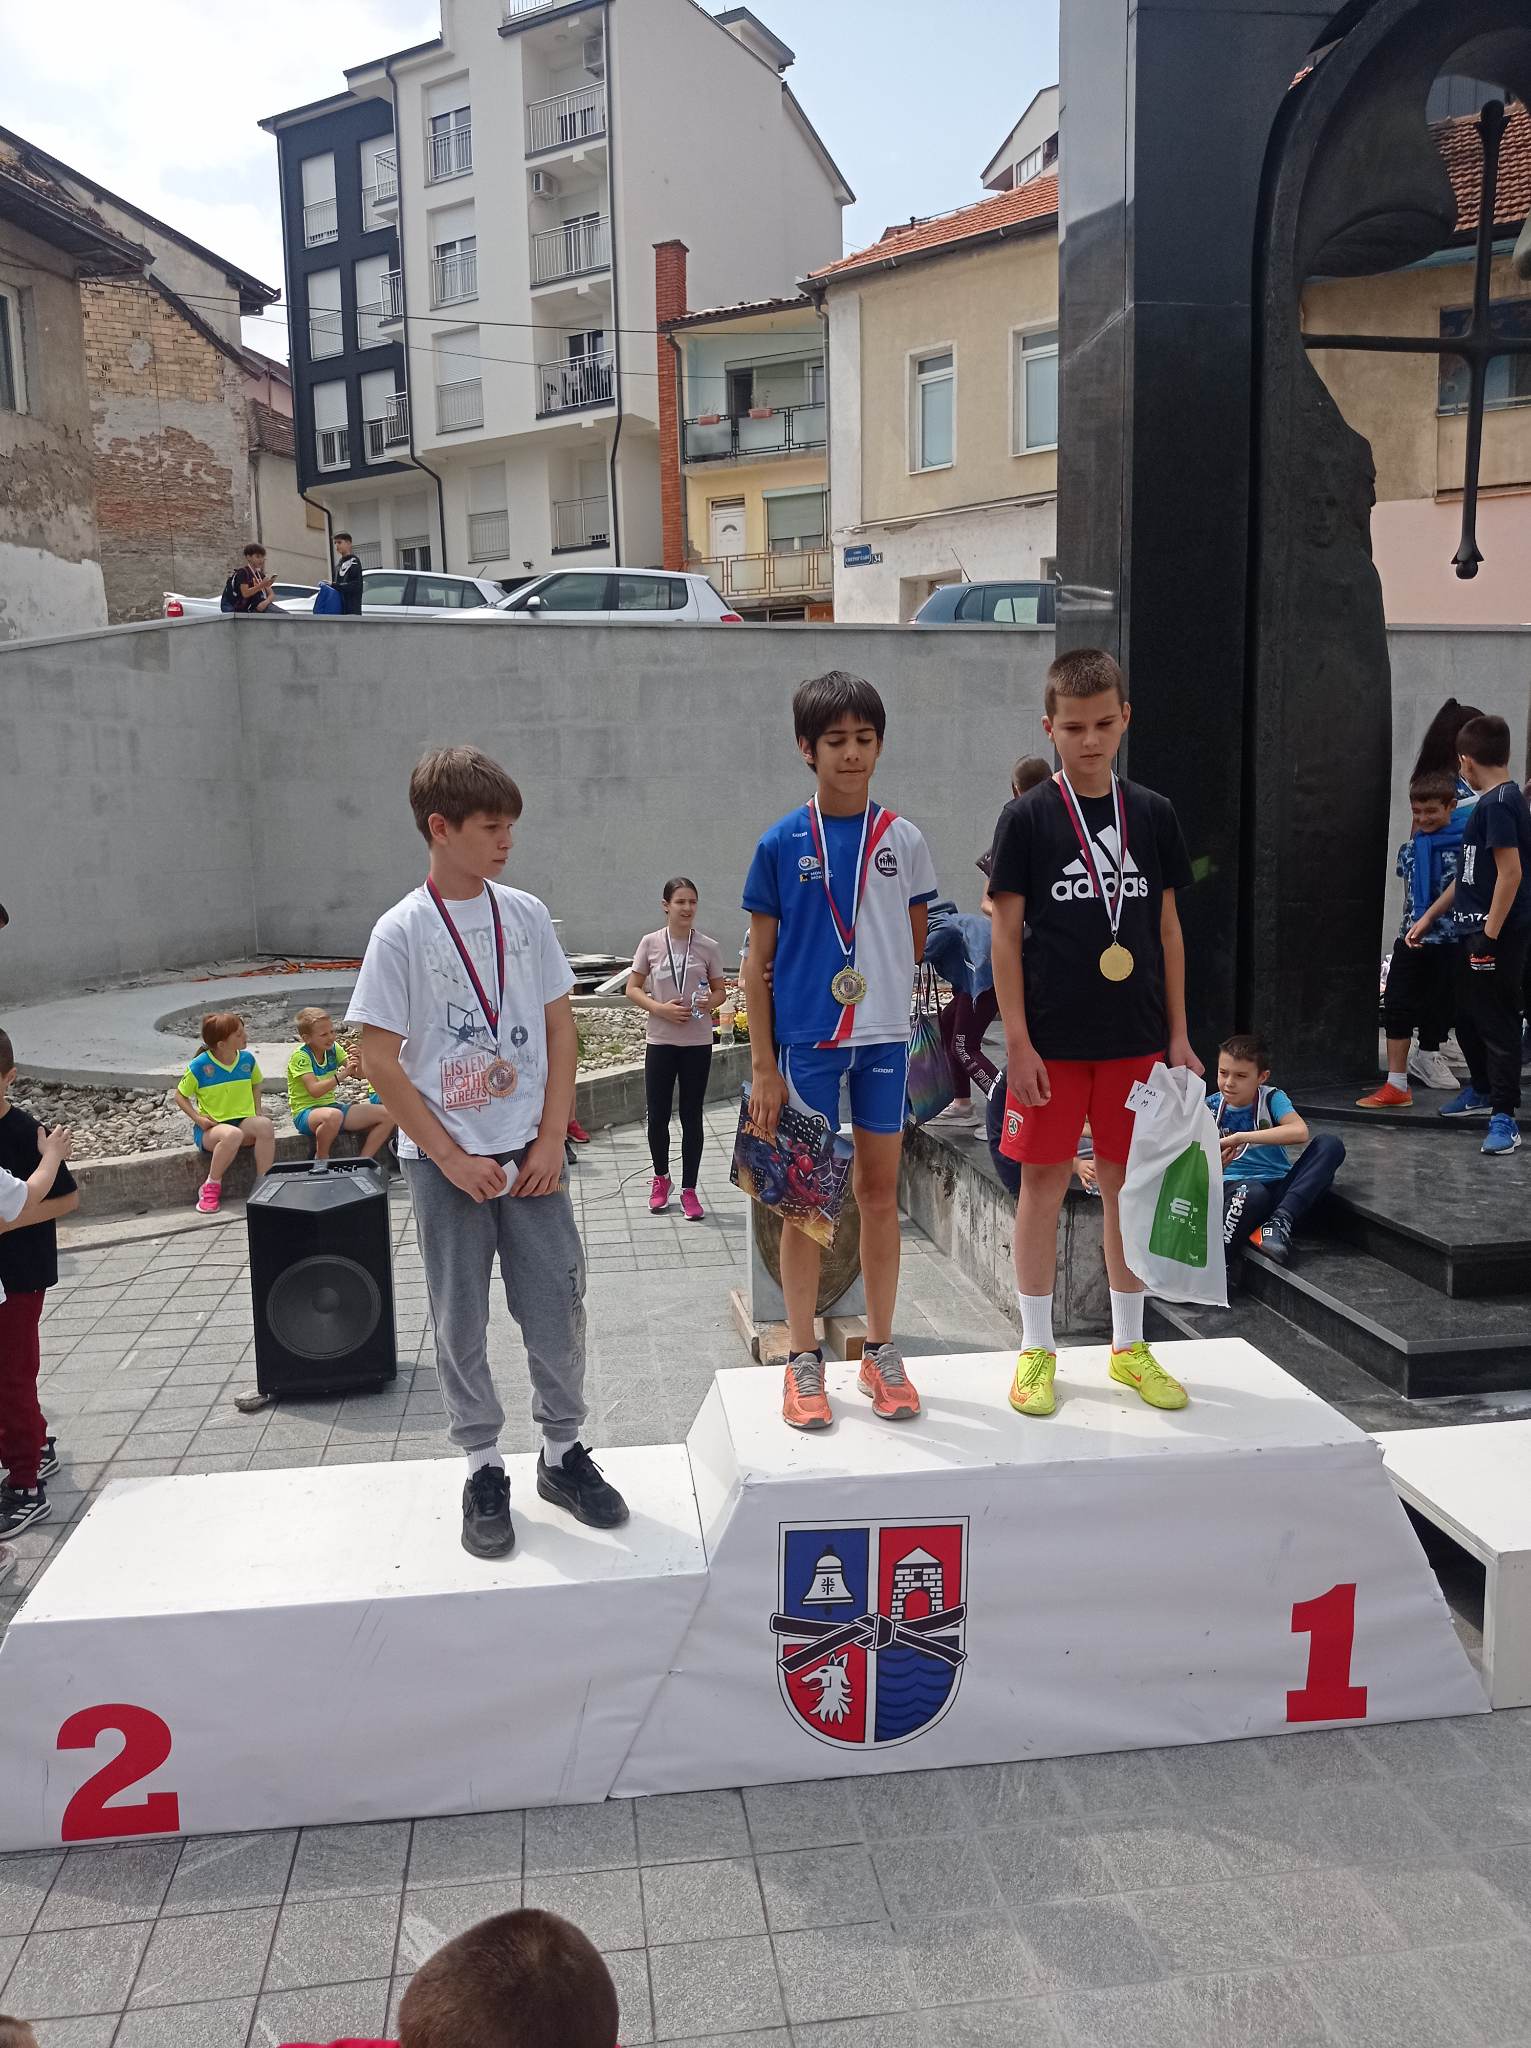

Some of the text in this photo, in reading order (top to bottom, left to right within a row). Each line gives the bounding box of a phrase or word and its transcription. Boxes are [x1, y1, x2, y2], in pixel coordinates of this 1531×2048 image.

[1051, 871, 1148, 901] addas
[444, 1054, 487, 1078] LISTEN
[444, 1076, 454, 1088] TO
[446, 1087, 488, 1104] STREETS
[1286, 1583, 1367, 1722] 1
[57, 1703, 180, 1841] 2
